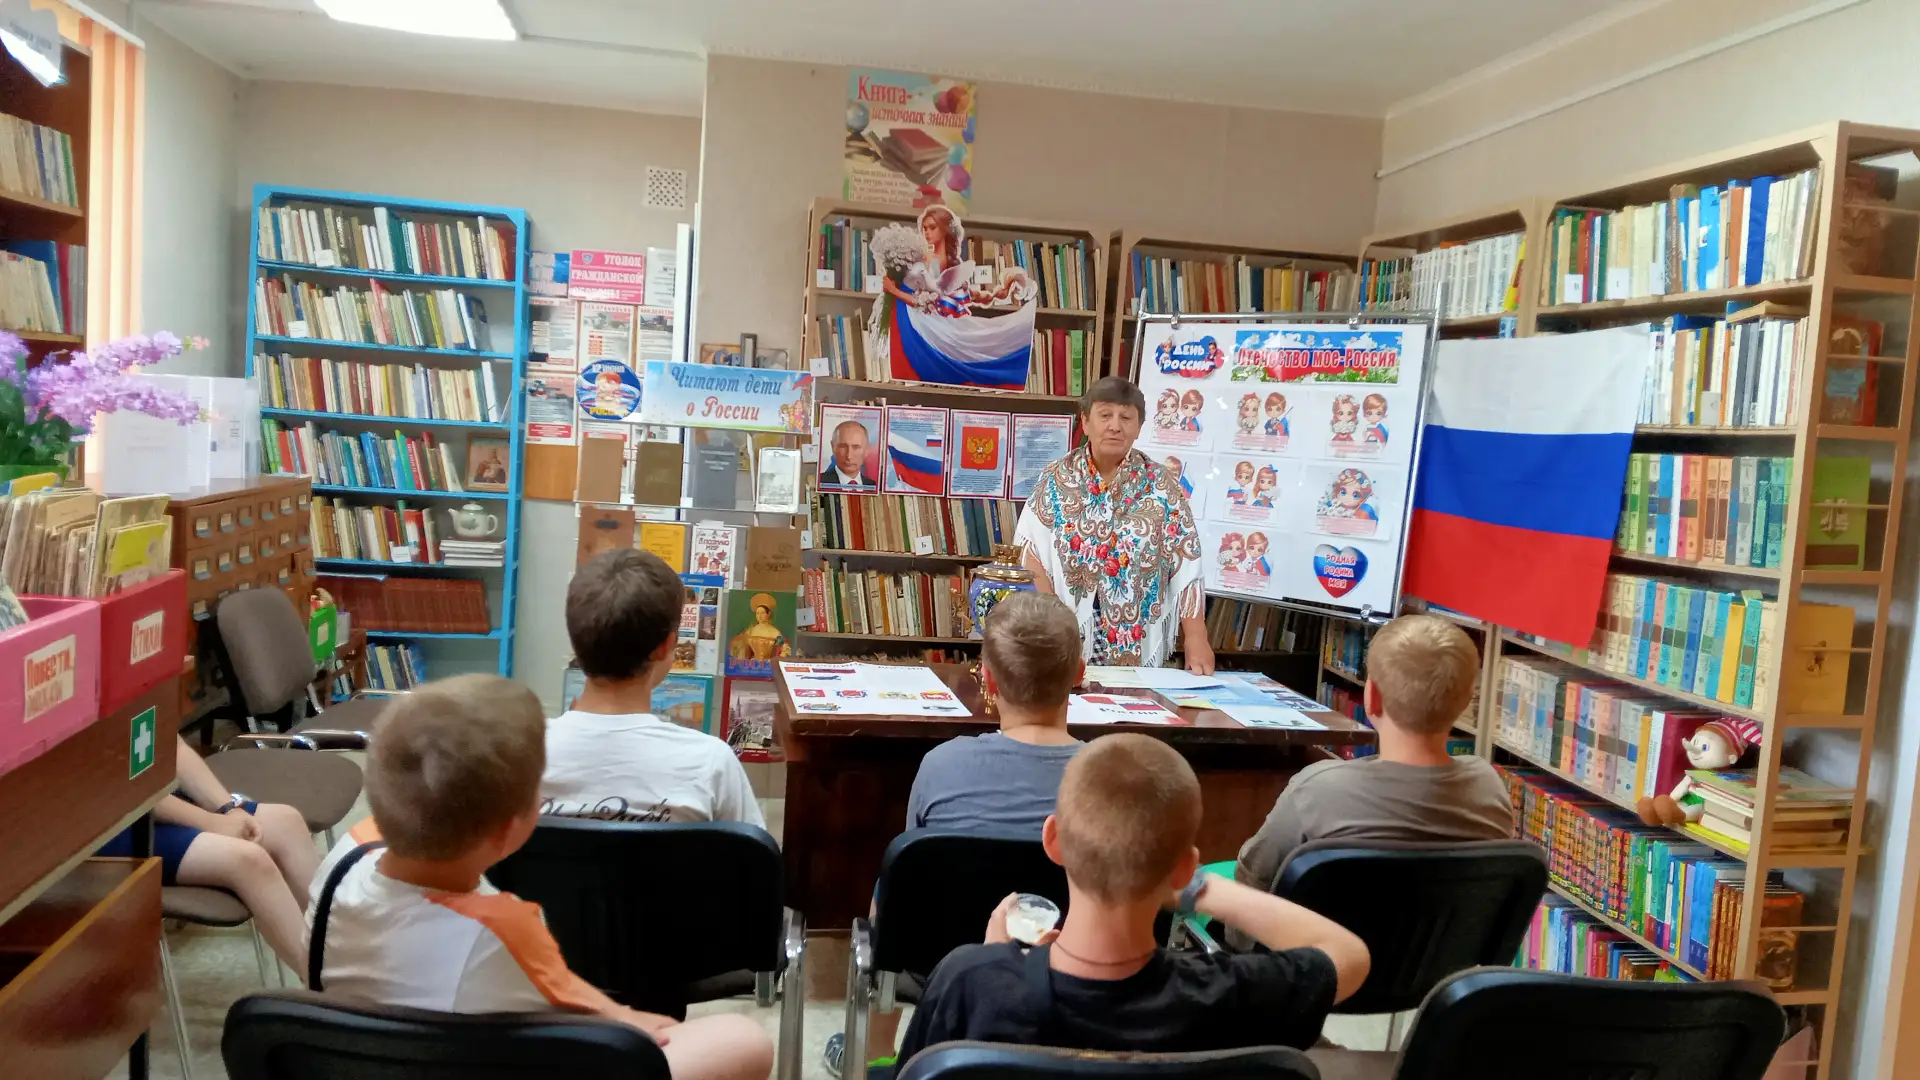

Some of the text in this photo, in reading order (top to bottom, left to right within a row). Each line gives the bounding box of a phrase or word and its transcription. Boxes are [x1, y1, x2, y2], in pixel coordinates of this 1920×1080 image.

[857, 75, 913, 105] Книга-
[871, 107, 968, 129] источник знаний!
[604, 254, 642, 267] УГОЛОК
[571, 269, 643, 284] ГРАЖДАНСКОЙ
[1173, 344, 1205, 356] ДЕНЬ
[1238, 348, 1396, 368] Отечество мое-Россия
[1163, 360, 1214, 372] РОССИИ
[671, 366, 784, 396] Читают дети
[686, 396, 760, 421] о России
[1325, 554, 1356, 565] РОДНАЯ
[1324, 565, 1354, 577] РОДИНА
[1328, 578, 1347, 589] МОЯ
